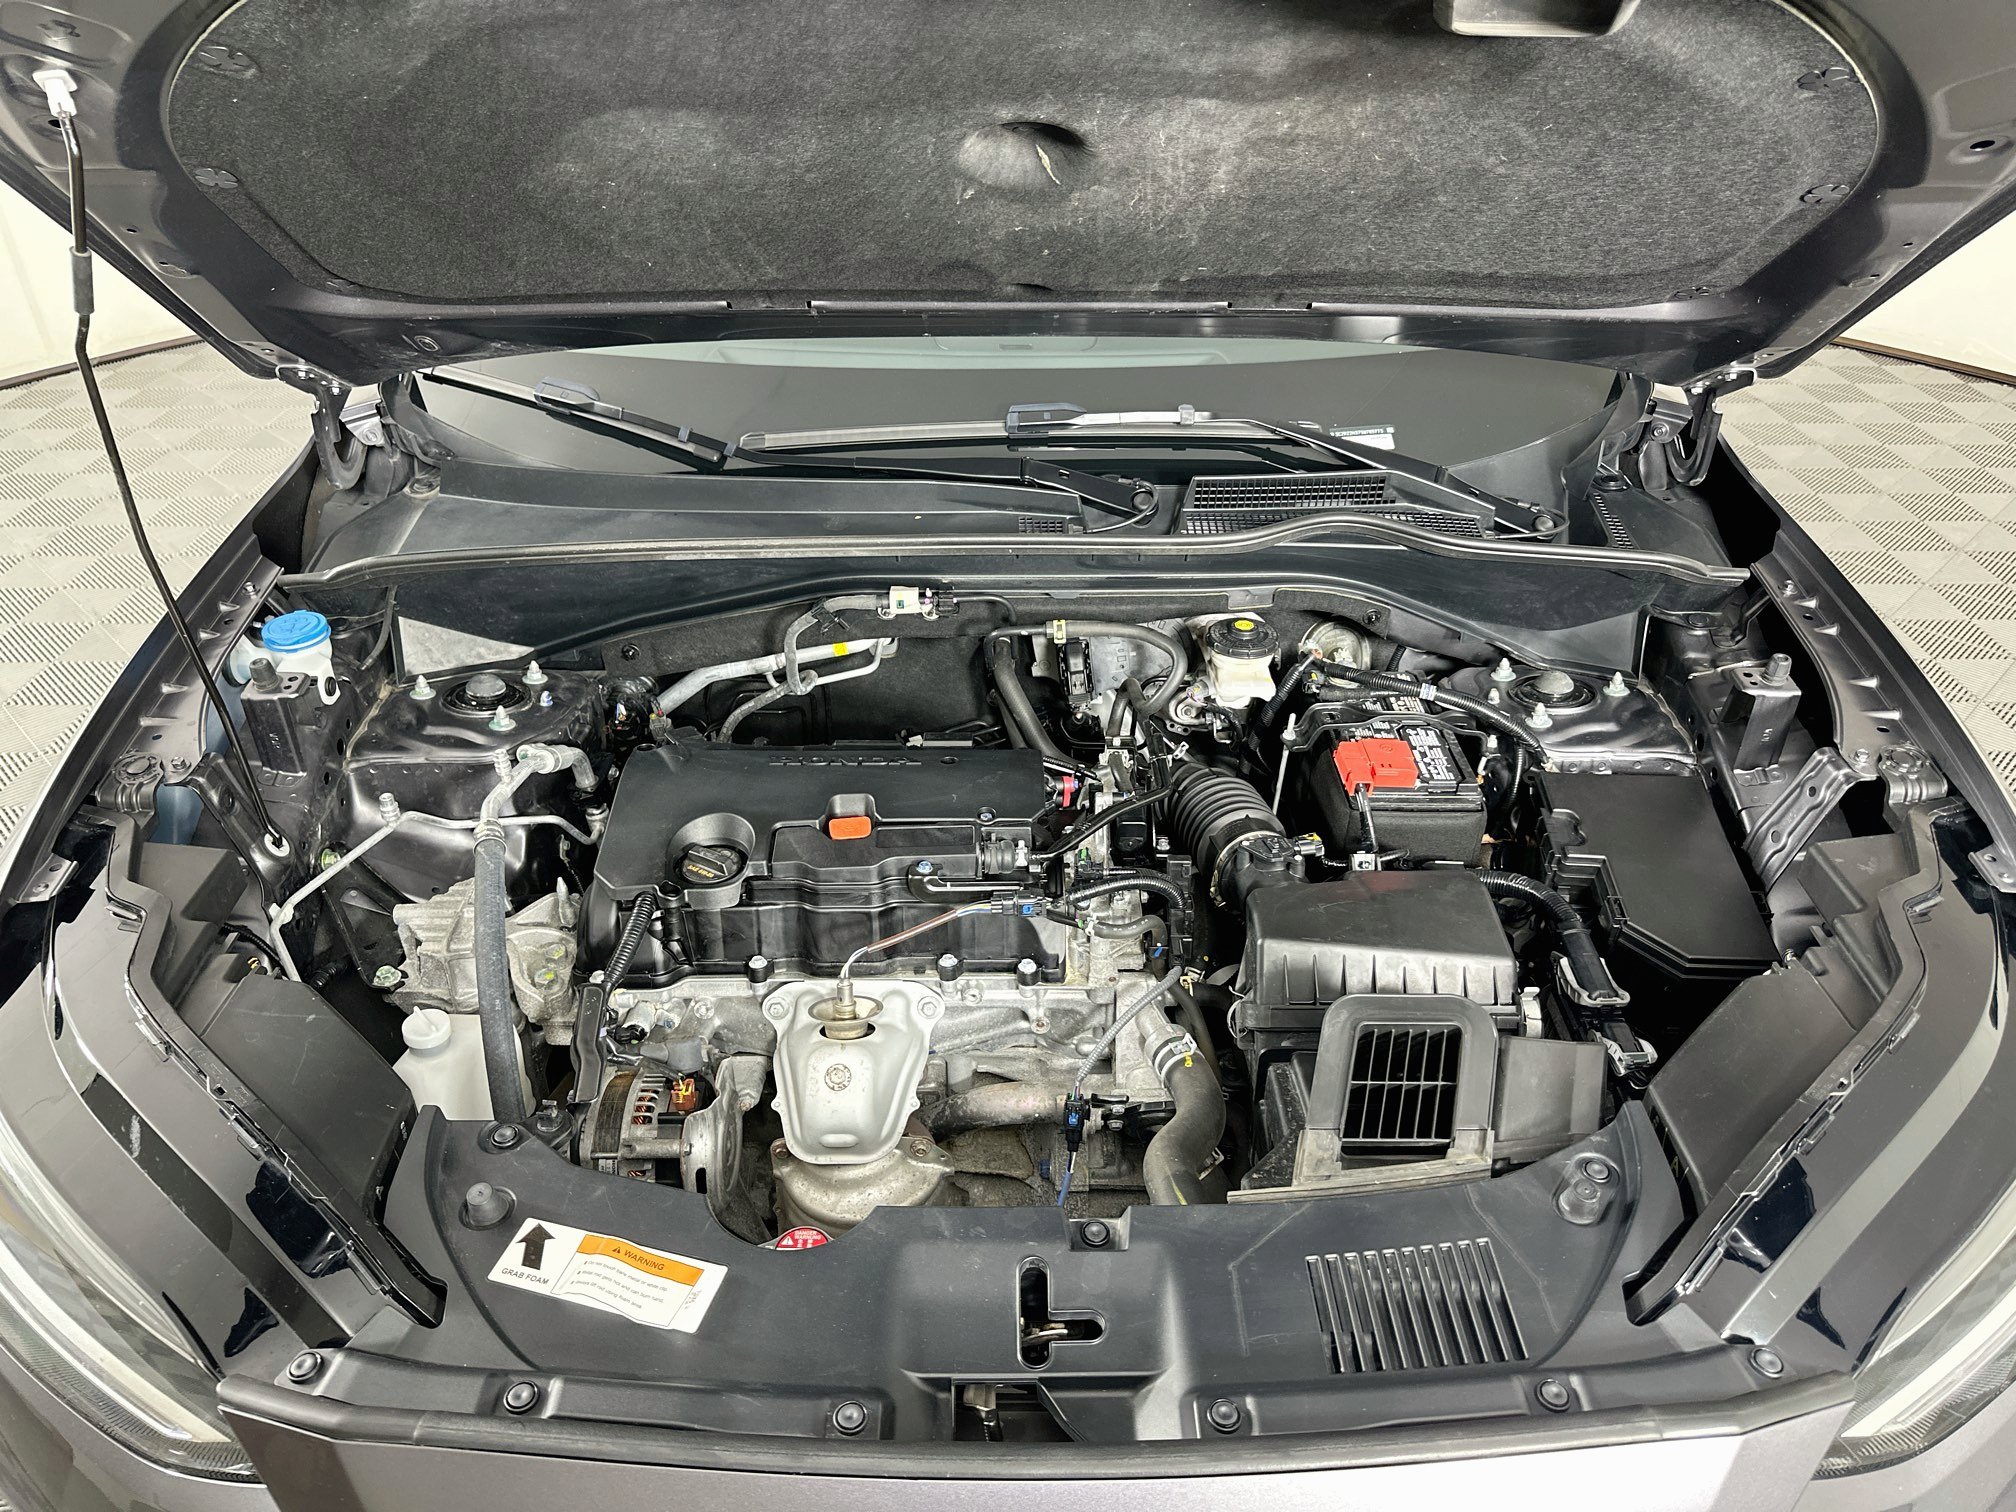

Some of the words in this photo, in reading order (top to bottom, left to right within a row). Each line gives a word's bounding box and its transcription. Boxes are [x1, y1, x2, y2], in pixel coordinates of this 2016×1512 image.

[769, 755, 922, 766] HONDA
[624, 1250, 665, 1271] WARNING
[501, 1267, 526, 1282] GRAB
[526, 1273, 550, 1286] FOAM
